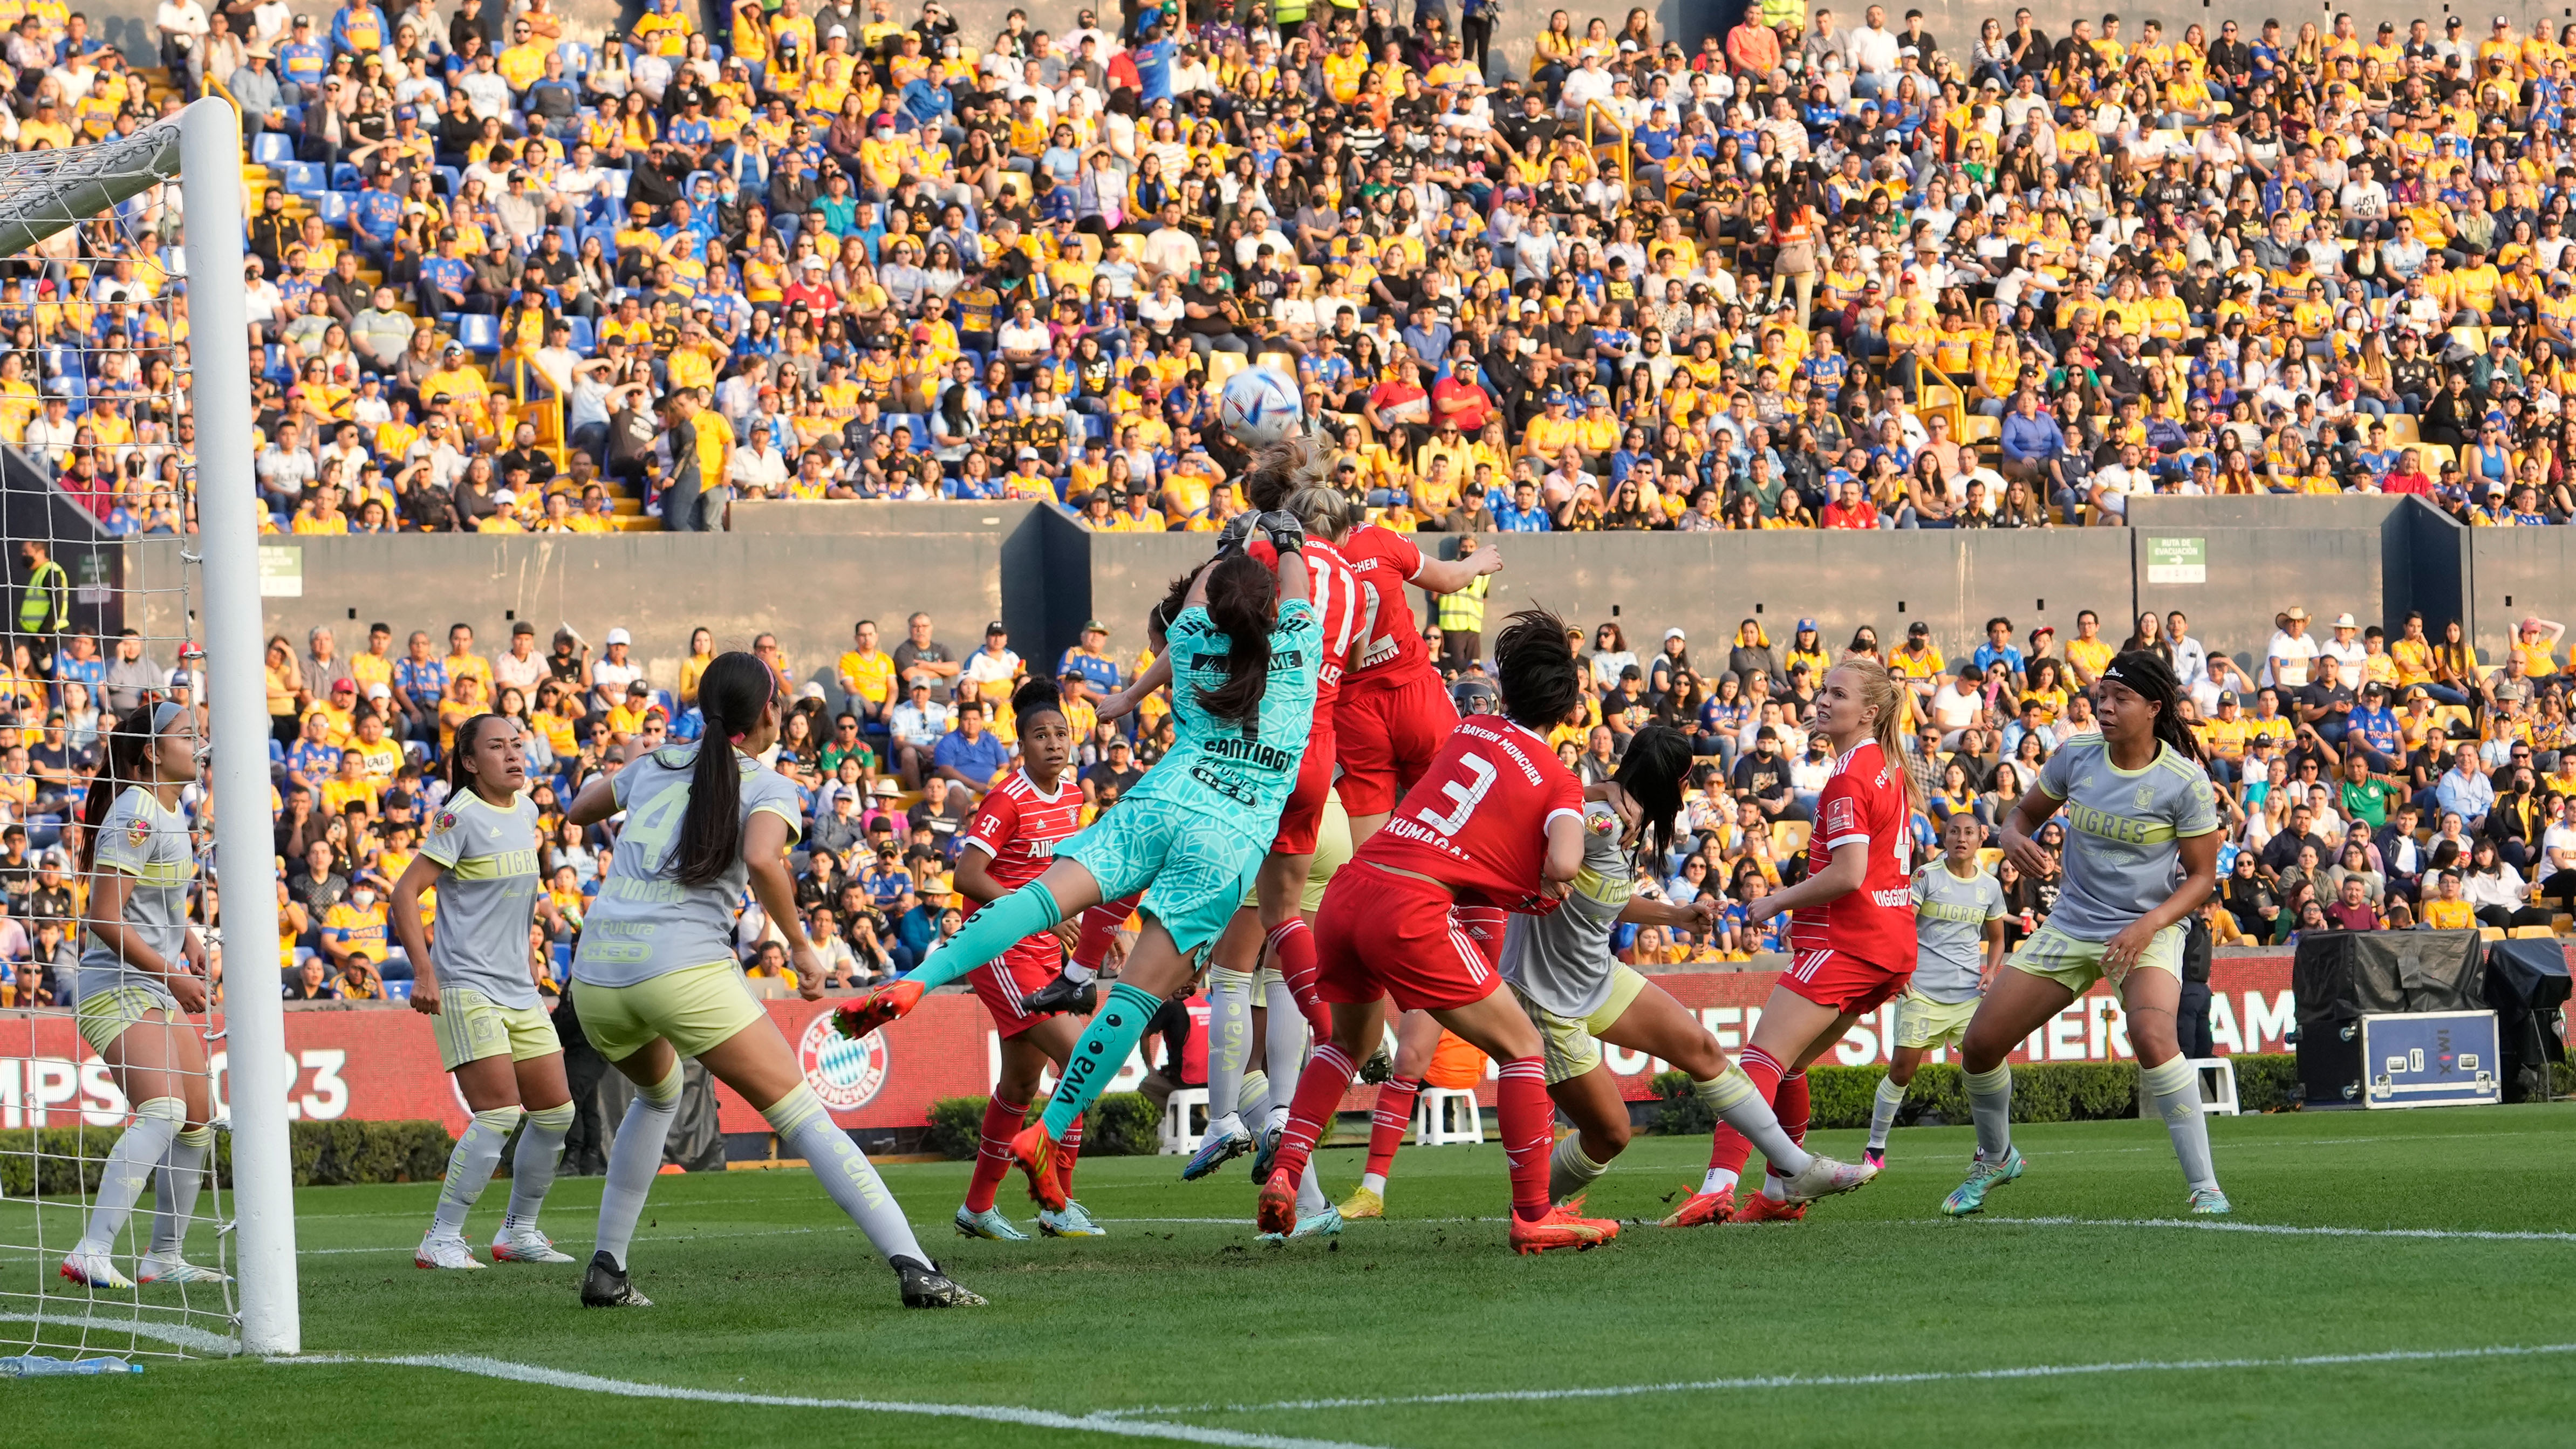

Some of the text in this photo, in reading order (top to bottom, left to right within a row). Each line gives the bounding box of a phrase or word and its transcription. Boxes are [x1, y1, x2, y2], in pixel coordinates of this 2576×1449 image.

[2354, 195, 2375, 206] JUST
[1462, 723, 1502, 742] BAYERN
[1416, 751, 1497, 837] 3
[625, 781, 692, 869] 4
[980, 815, 1002, 837] T
[2071, 801, 2147, 844] TIGRES
[1027, 839, 1056, 858] Alli
[1936, 903, 1985, 924] TIGRES
[598, 918, 656, 936] Futura
[2024, 933, 2068, 970] 10
[1918, 1017, 1929, 1040] 9
[1055, 1055, 1096, 1105] viva
[842, 1155, 885, 1211] viva
